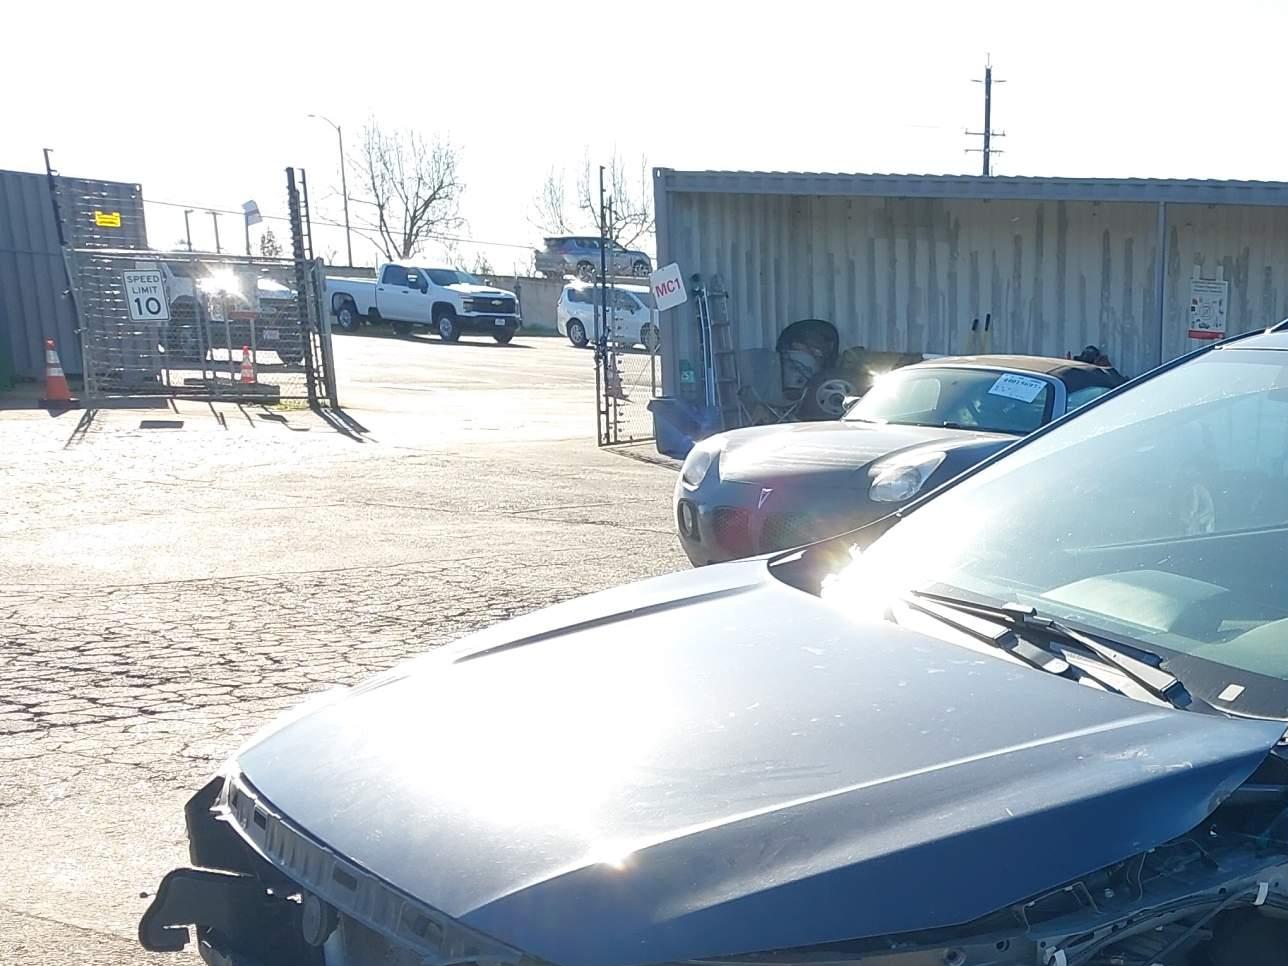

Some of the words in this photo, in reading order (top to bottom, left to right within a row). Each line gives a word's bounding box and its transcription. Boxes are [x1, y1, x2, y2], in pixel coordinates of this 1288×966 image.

[127, 275, 160, 283] SPEED
[131, 286, 157, 294] LIMIT
[655, 278, 681, 298] MC1
[134, 297, 161, 315] 10
